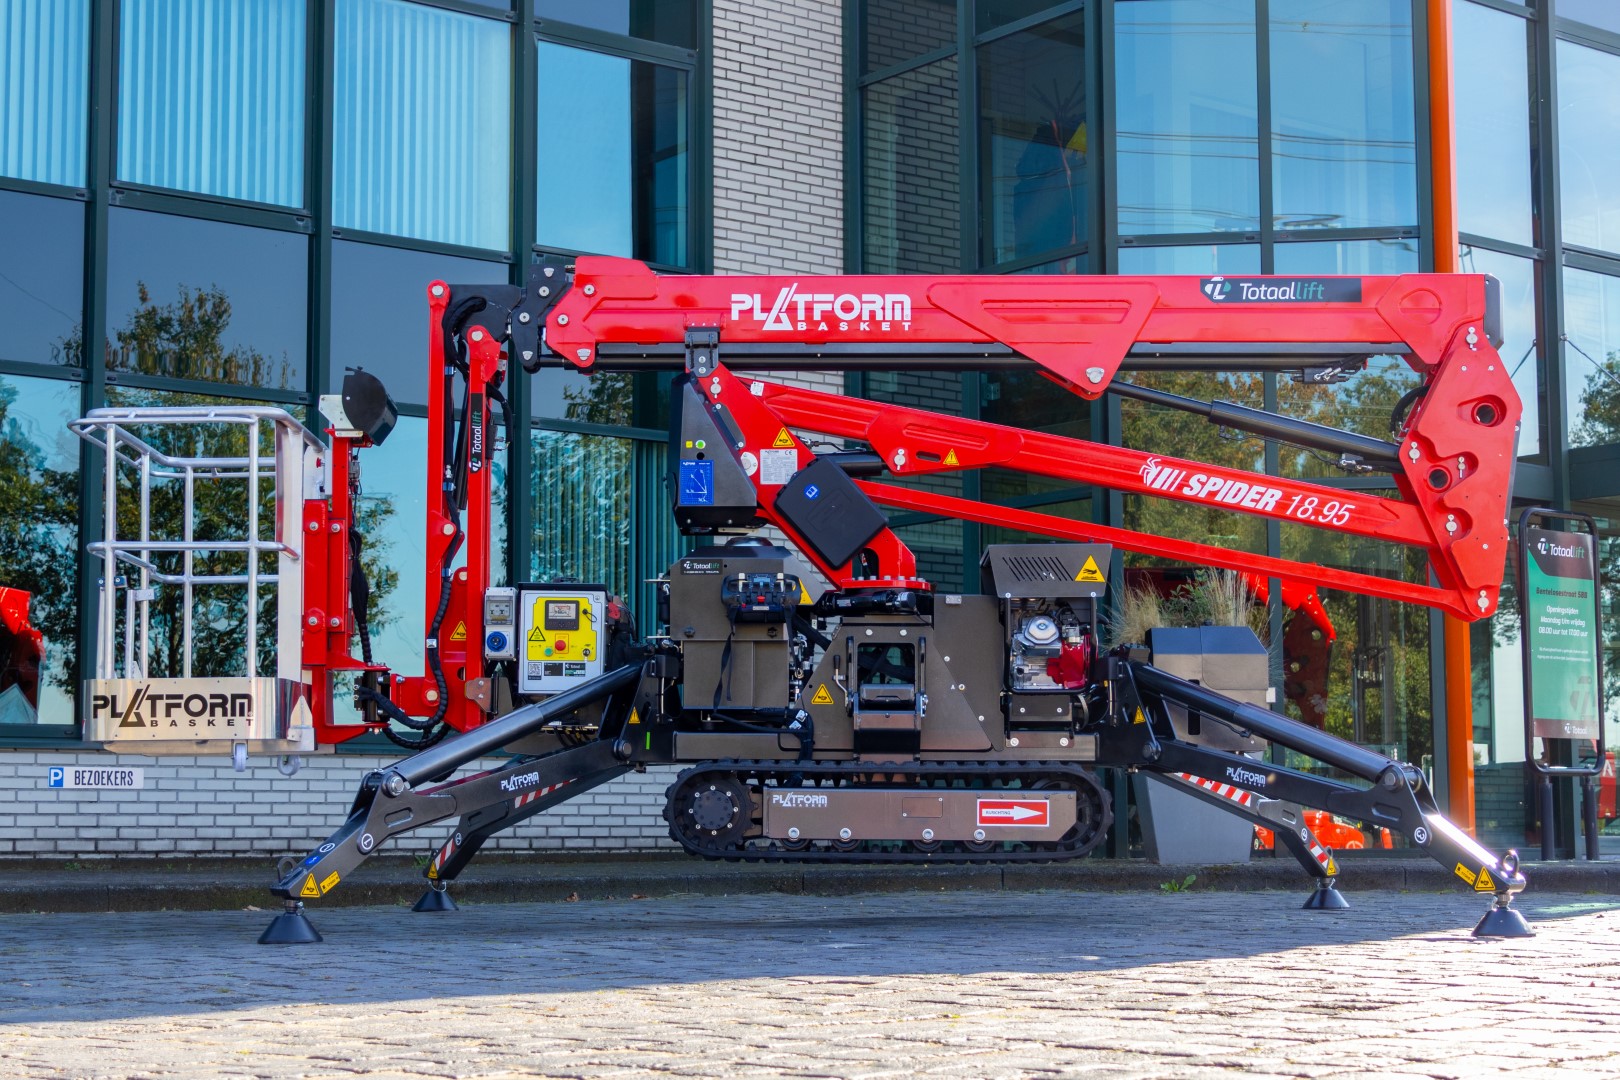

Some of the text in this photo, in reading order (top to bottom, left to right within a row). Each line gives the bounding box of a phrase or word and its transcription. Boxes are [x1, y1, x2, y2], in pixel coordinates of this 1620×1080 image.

[1240, 281, 1325, 300] Totaallift
[731, 283, 912, 331] PLATFORM
[797, 322, 912, 331] BASKET
[472, 411, 482, 454] Totaallift
[1183, 474, 1355, 526] SPIDER 18.95
[1549, 543, 1585, 559] Totaallift
[1546, 605, 1579, 616] Openingstijden
[93, 684, 252, 727] PLATFORM
[150, 718, 254, 727] BASKET
[50, 768, 134, 787] P BEZOEKERS
[500, 771, 540, 791] PLATFORM
[1226, 766, 1266, 785] PLATFORM
[772, 791, 828, 807] PLATFORM
